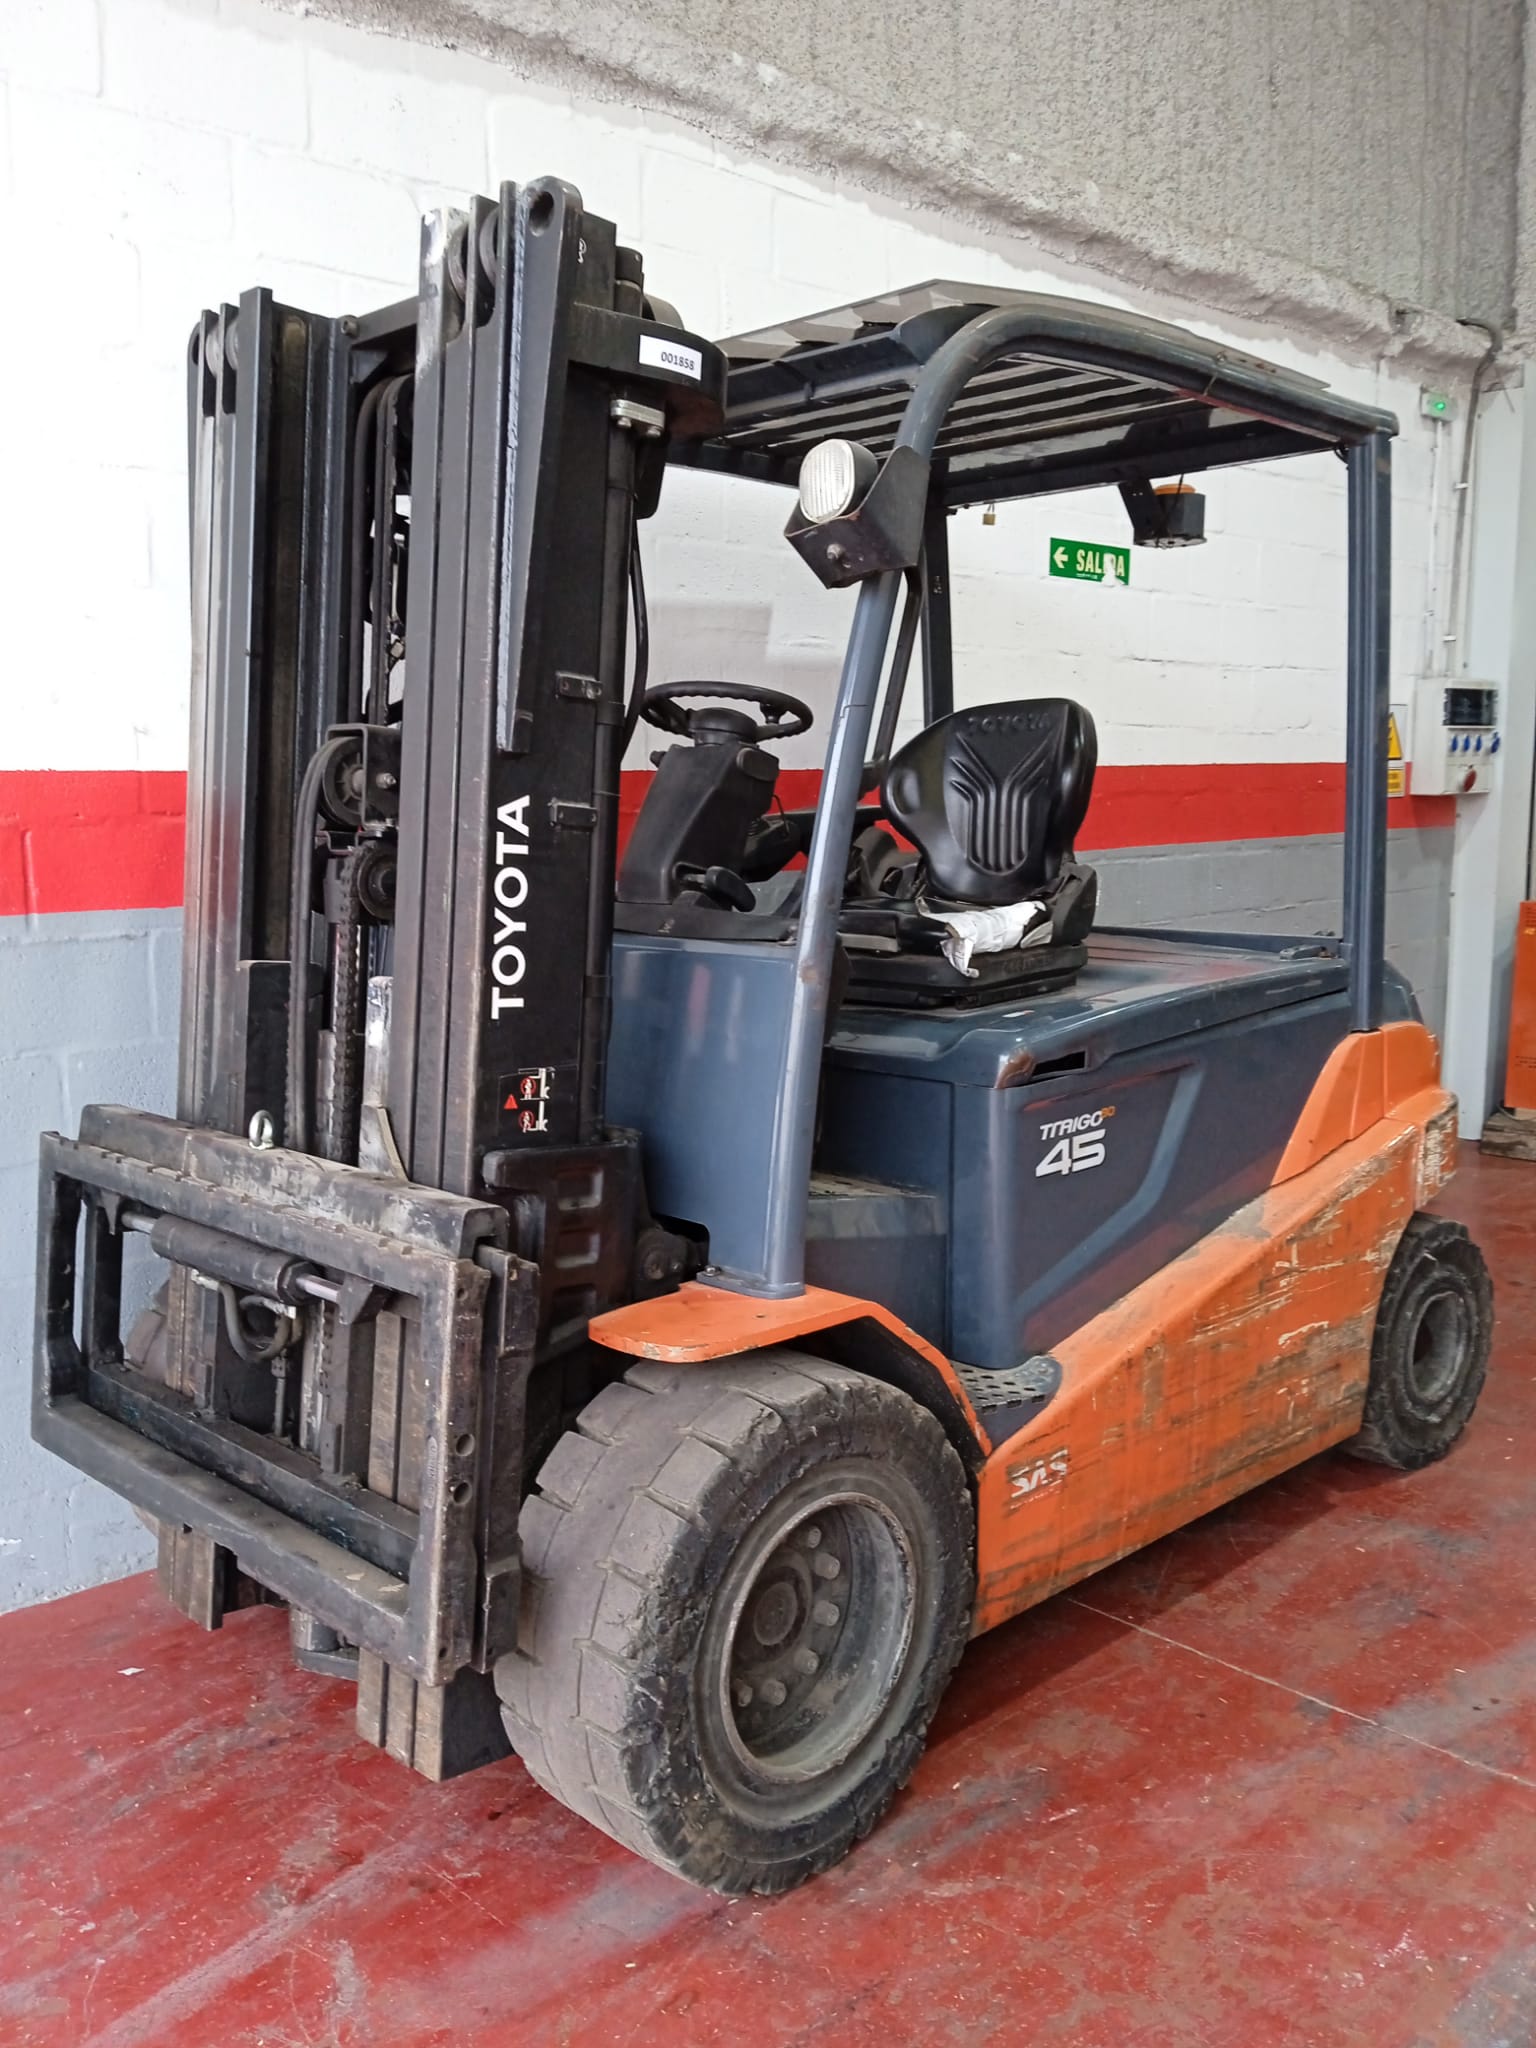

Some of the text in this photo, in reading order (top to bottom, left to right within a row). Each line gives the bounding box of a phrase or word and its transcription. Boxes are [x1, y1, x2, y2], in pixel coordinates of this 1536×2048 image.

[661, 351, 695, 371] 001858
[1076, 549, 1125, 577] SALDA
[491, 795, 531, 1020] TOYOTA
[1035, 1128, 1106, 1177] 45
